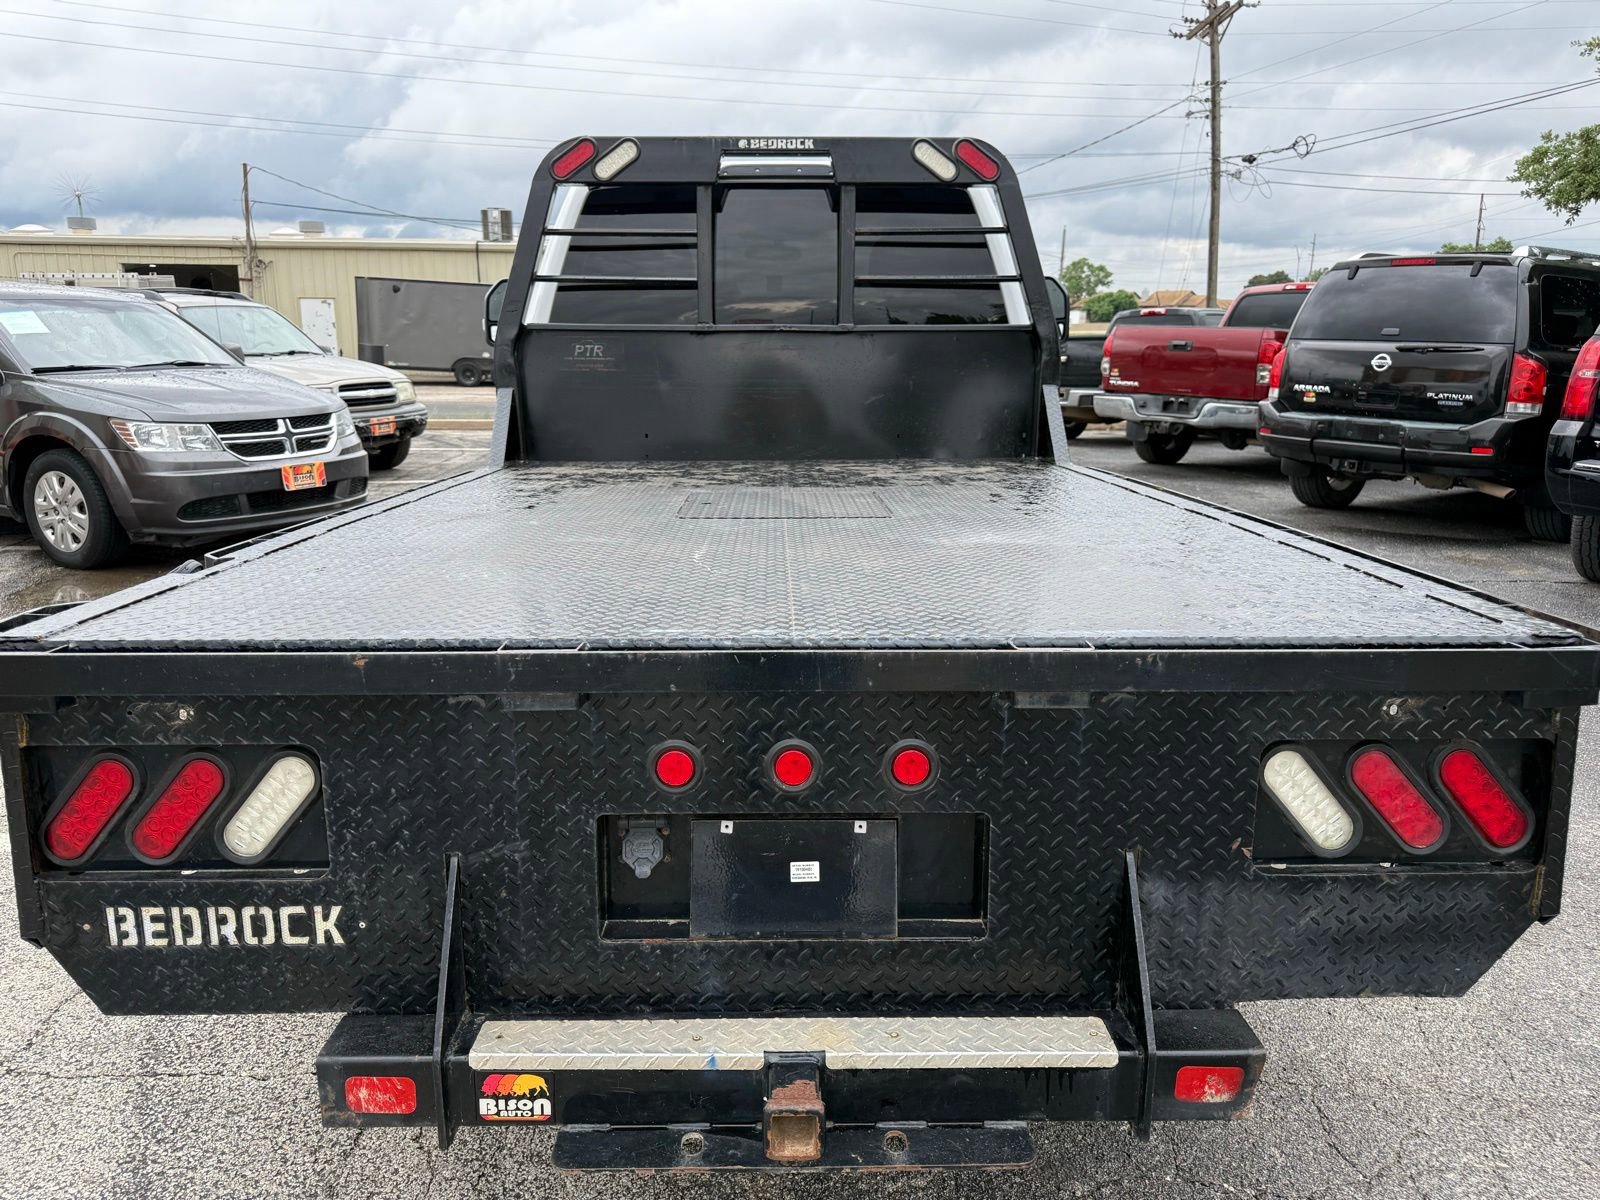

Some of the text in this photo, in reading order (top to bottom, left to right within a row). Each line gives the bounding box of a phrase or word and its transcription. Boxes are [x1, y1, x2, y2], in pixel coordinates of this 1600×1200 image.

[750, 138, 815, 149] BEDROCK
[574, 344, 604, 357] PTR
[1293, 384, 1331, 393] ARMADA
[1426, 392, 1473, 401] PLATINUM
[105, 905, 345, 947] BEDROCK
